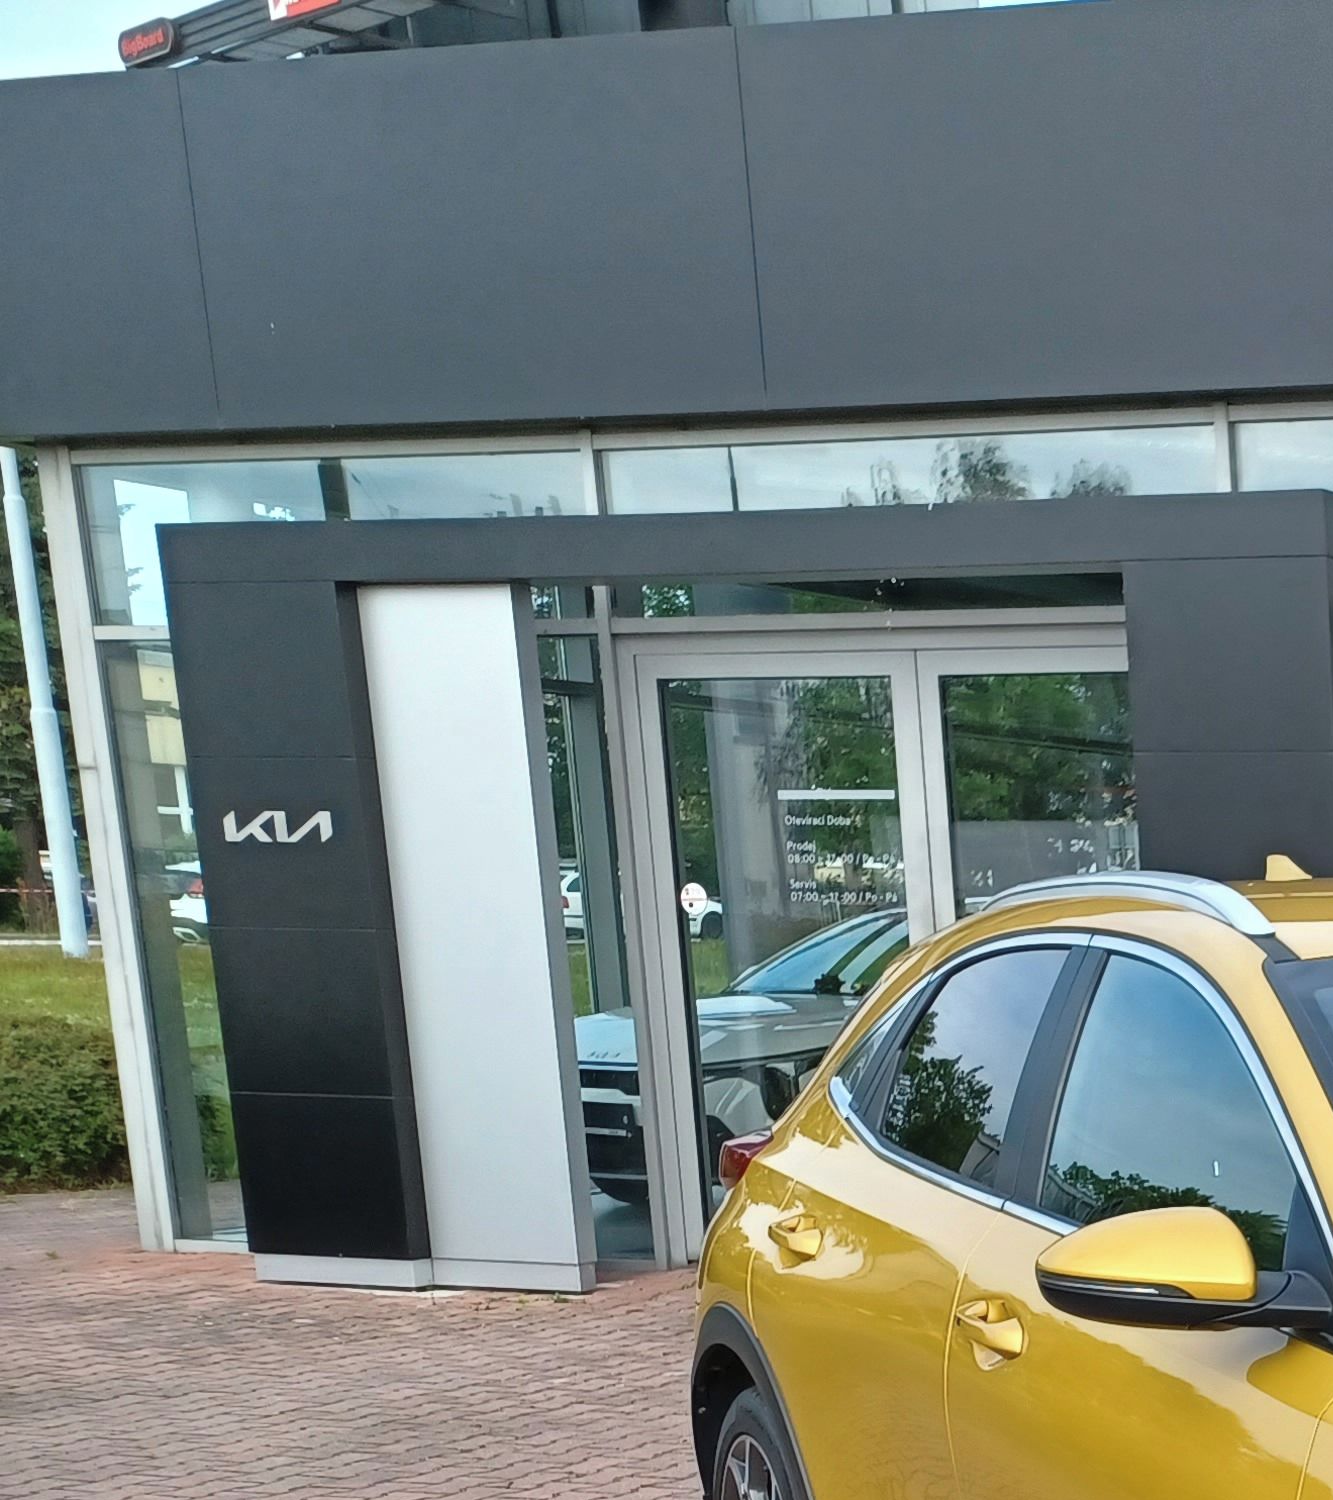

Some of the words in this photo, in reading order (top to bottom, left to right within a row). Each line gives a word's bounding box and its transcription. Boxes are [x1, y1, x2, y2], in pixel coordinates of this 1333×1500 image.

[121, 28, 164, 57] BigBoard
[223, 810, 333, 843] KIA
[786, 840, 816, 853] Prodej
[790, 879, 816, 890] Servis
